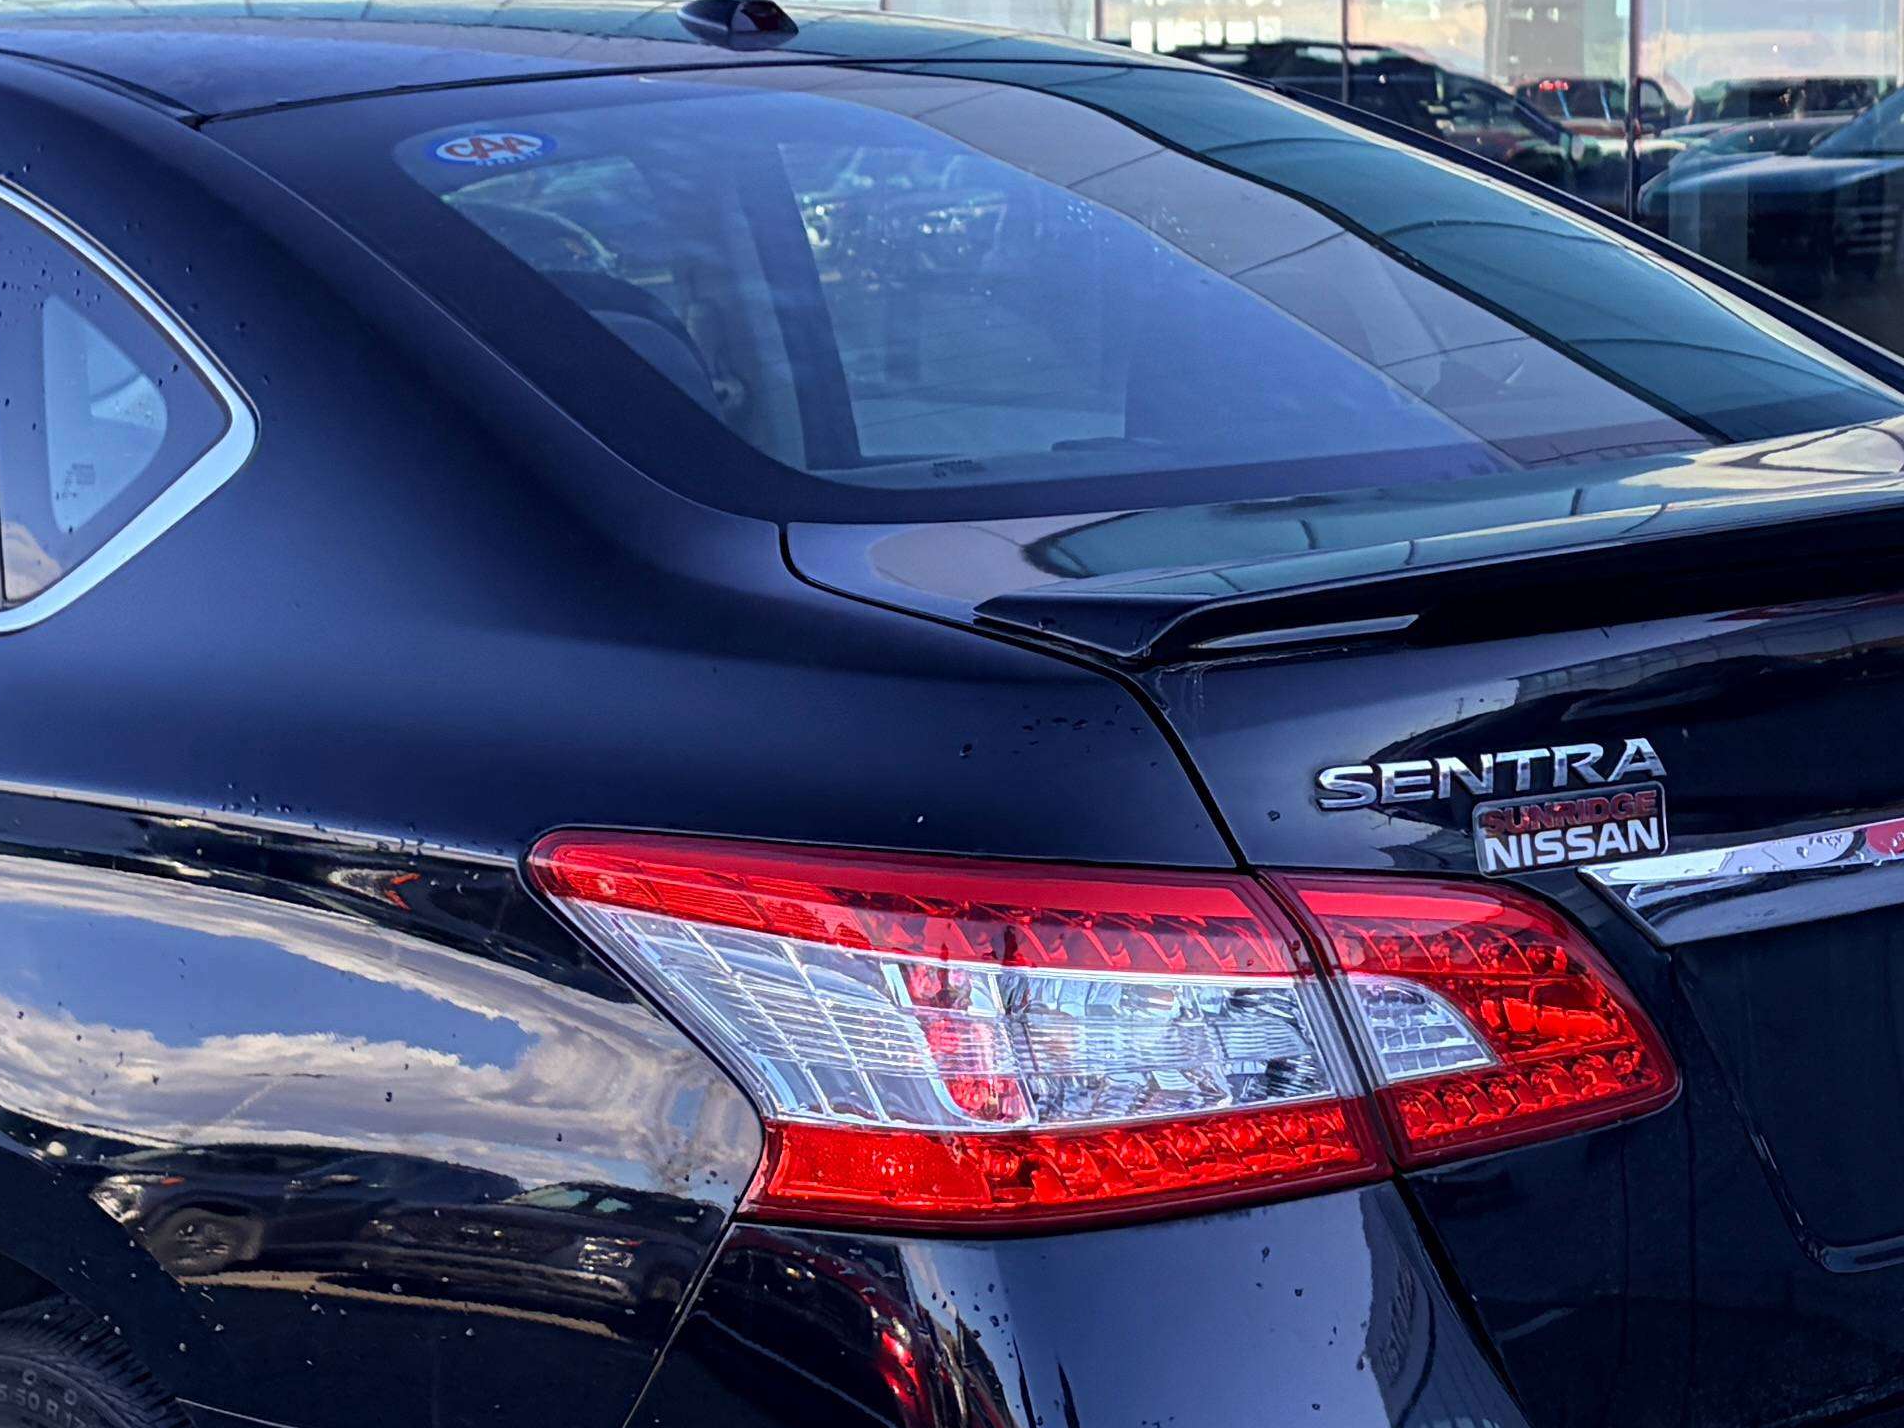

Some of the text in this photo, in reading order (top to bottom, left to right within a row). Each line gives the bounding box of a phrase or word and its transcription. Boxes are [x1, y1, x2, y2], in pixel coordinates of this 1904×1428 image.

[444, 136, 538, 159] CAA
[1315, 737, 1667, 809] SENTRA
[1482, 789, 1658, 835] SUNRIDGE
[1484, 816, 1660, 872] NISSAN
